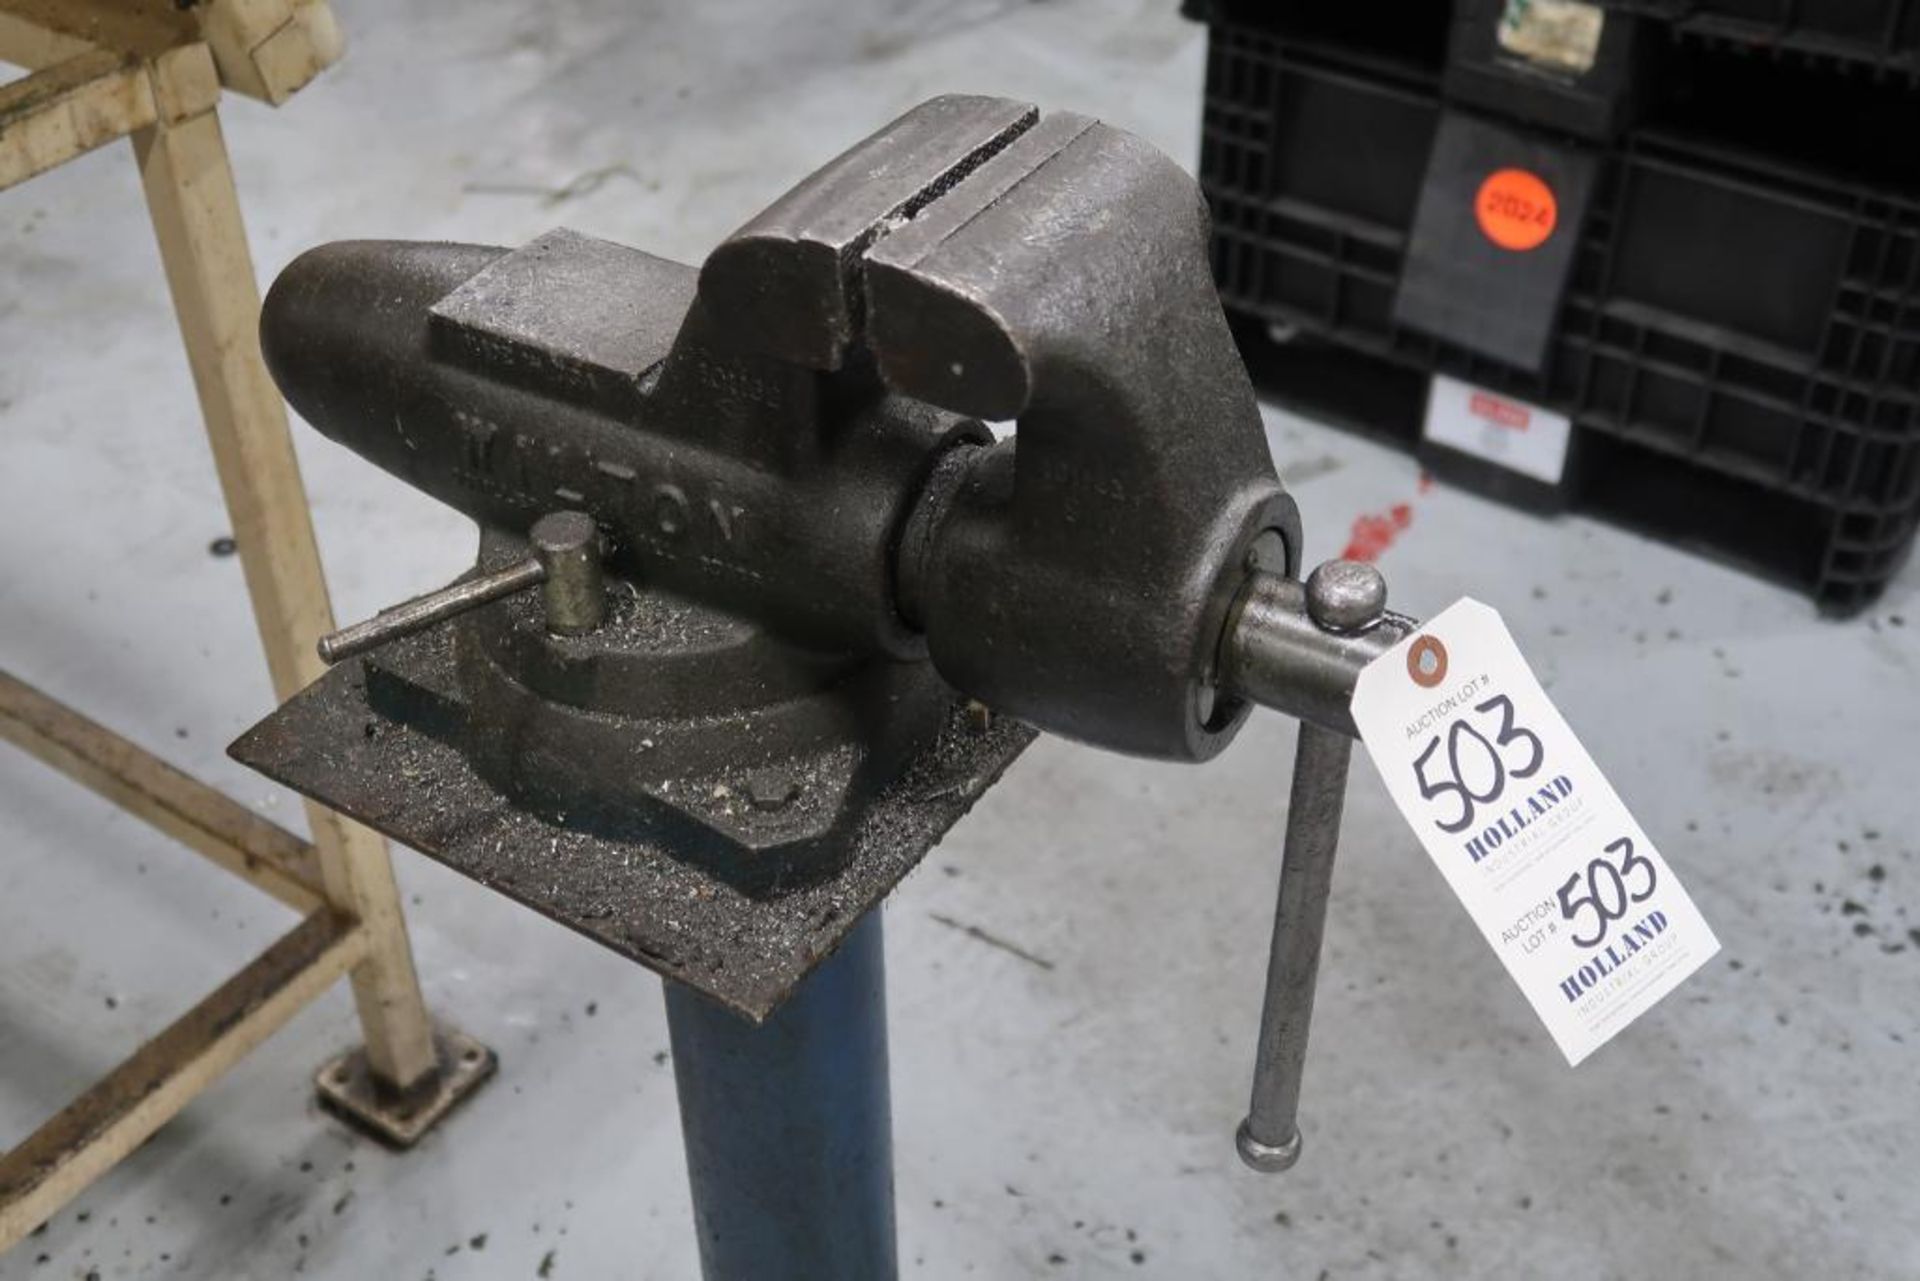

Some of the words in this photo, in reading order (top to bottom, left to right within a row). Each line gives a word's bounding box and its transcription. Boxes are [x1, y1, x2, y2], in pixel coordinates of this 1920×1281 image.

[1487, 190, 1547, 227] 2024
[1405, 699, 1457, 738] AUCTION
[1456, 680, 1480, 703] LOT
[1413, 694, 1544, 833] 503
[1464, 775, 1573, 863] HOLLAND
[1500, 898, 1556, 944] AUCTION
[1556, 836, 1657, 948] 503
[1522, 926, 1548, 954] LOT
[1548, 922, 1558, 934] #
[1559, 911, 1668, 1003] HOLLAND
